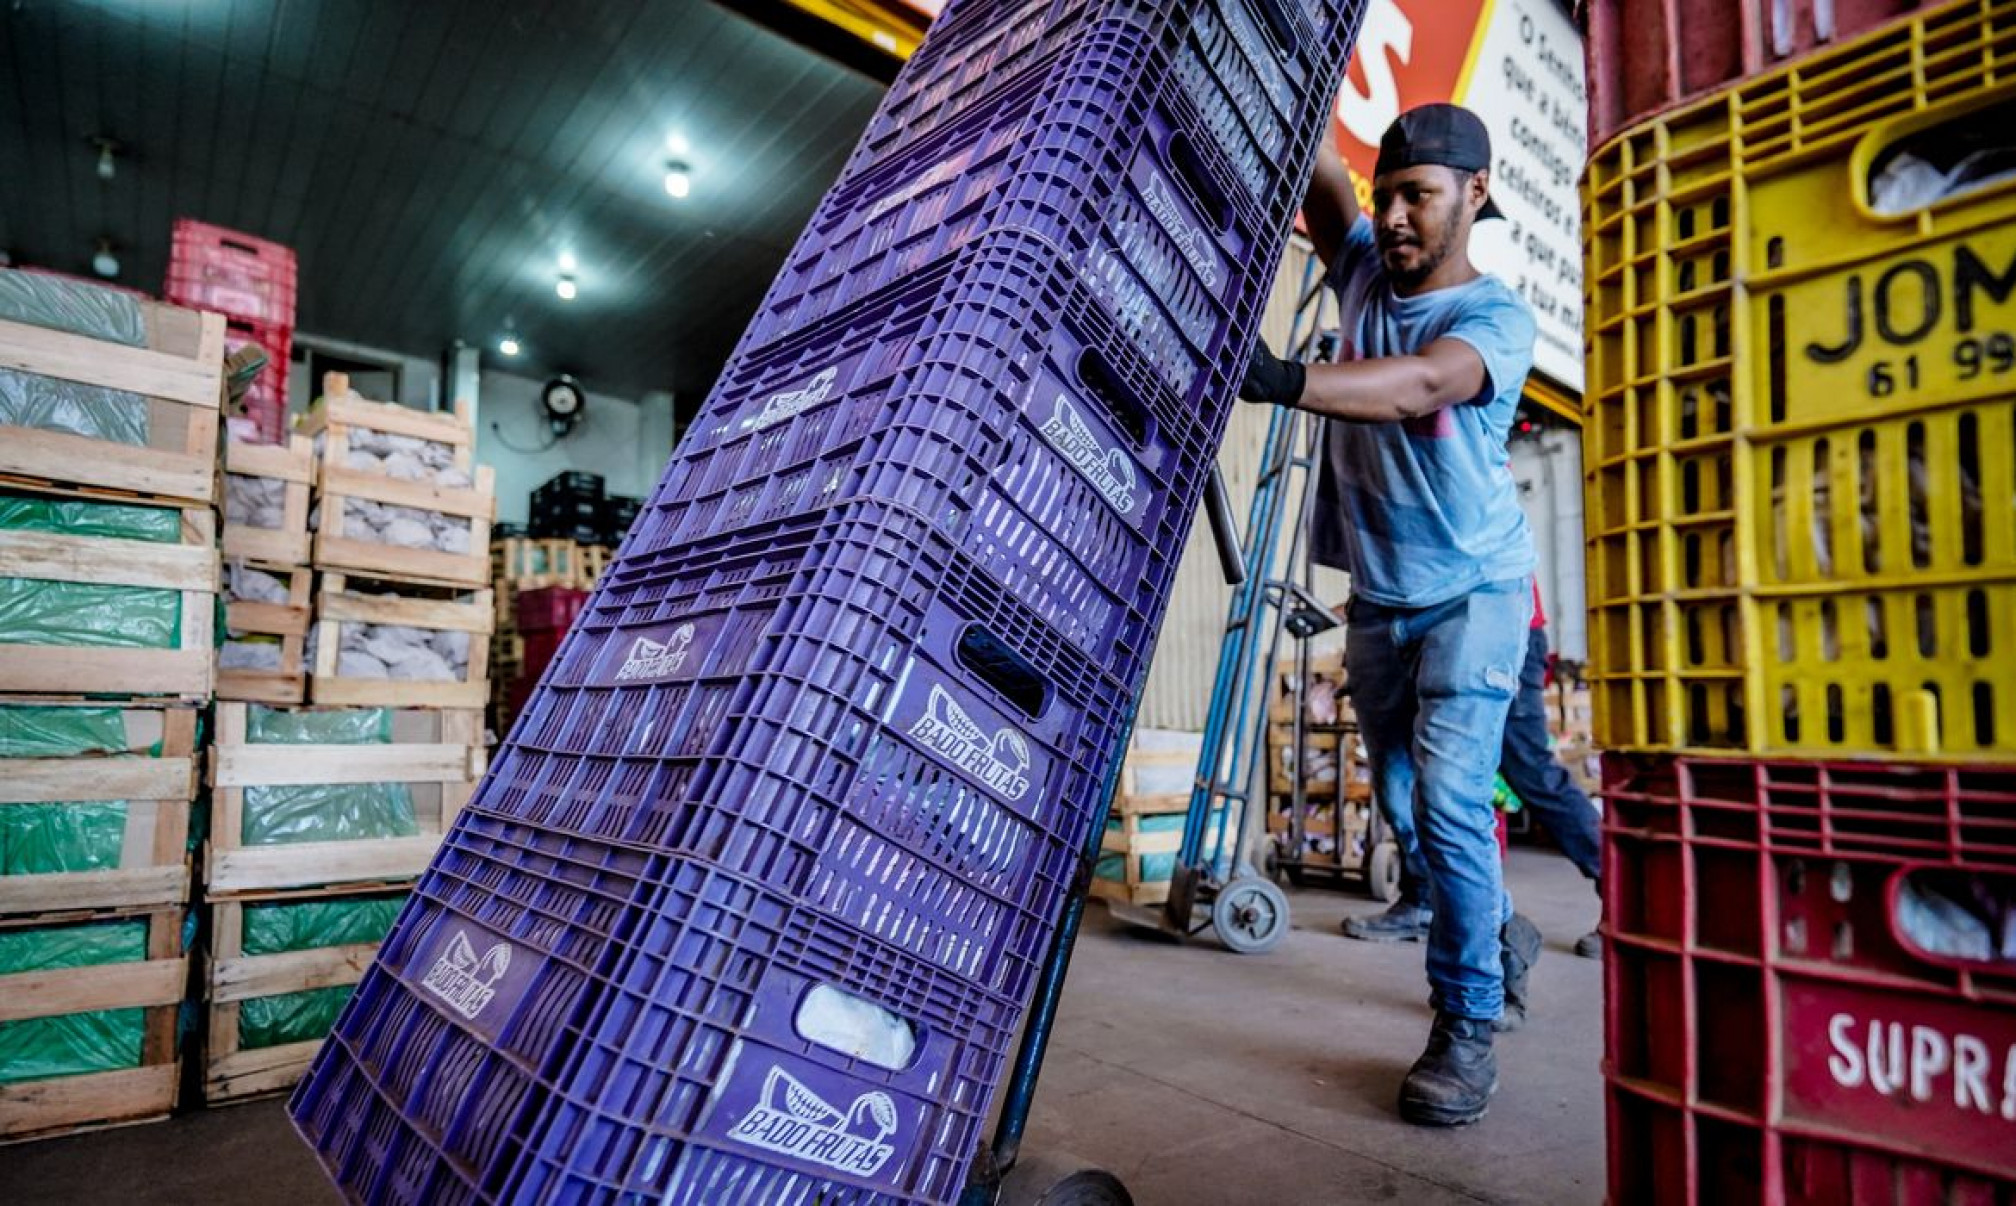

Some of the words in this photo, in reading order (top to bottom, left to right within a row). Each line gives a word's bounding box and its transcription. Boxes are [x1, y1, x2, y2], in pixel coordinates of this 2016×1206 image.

[1503, 55, 1534, 101] que
[1539, 93, 1548, 114] a
[1510, 117, 1570, 186] contigo
[1498, 159, 1561, 225] celeiros
[1525, 233, 1555, 270] que
[1805, 243, 2016, 363] JOM
[1042, 419, 1088, 463] BADO
[1084, 458, 1132, 513] FRUTAS
[913, 717, 969, 761] BADO
[961, 749, 1027, 800] FRUTAS
[740, 1109, 809, 1150] BADO
[805, 1128, 889, 1172] FRUTAS
